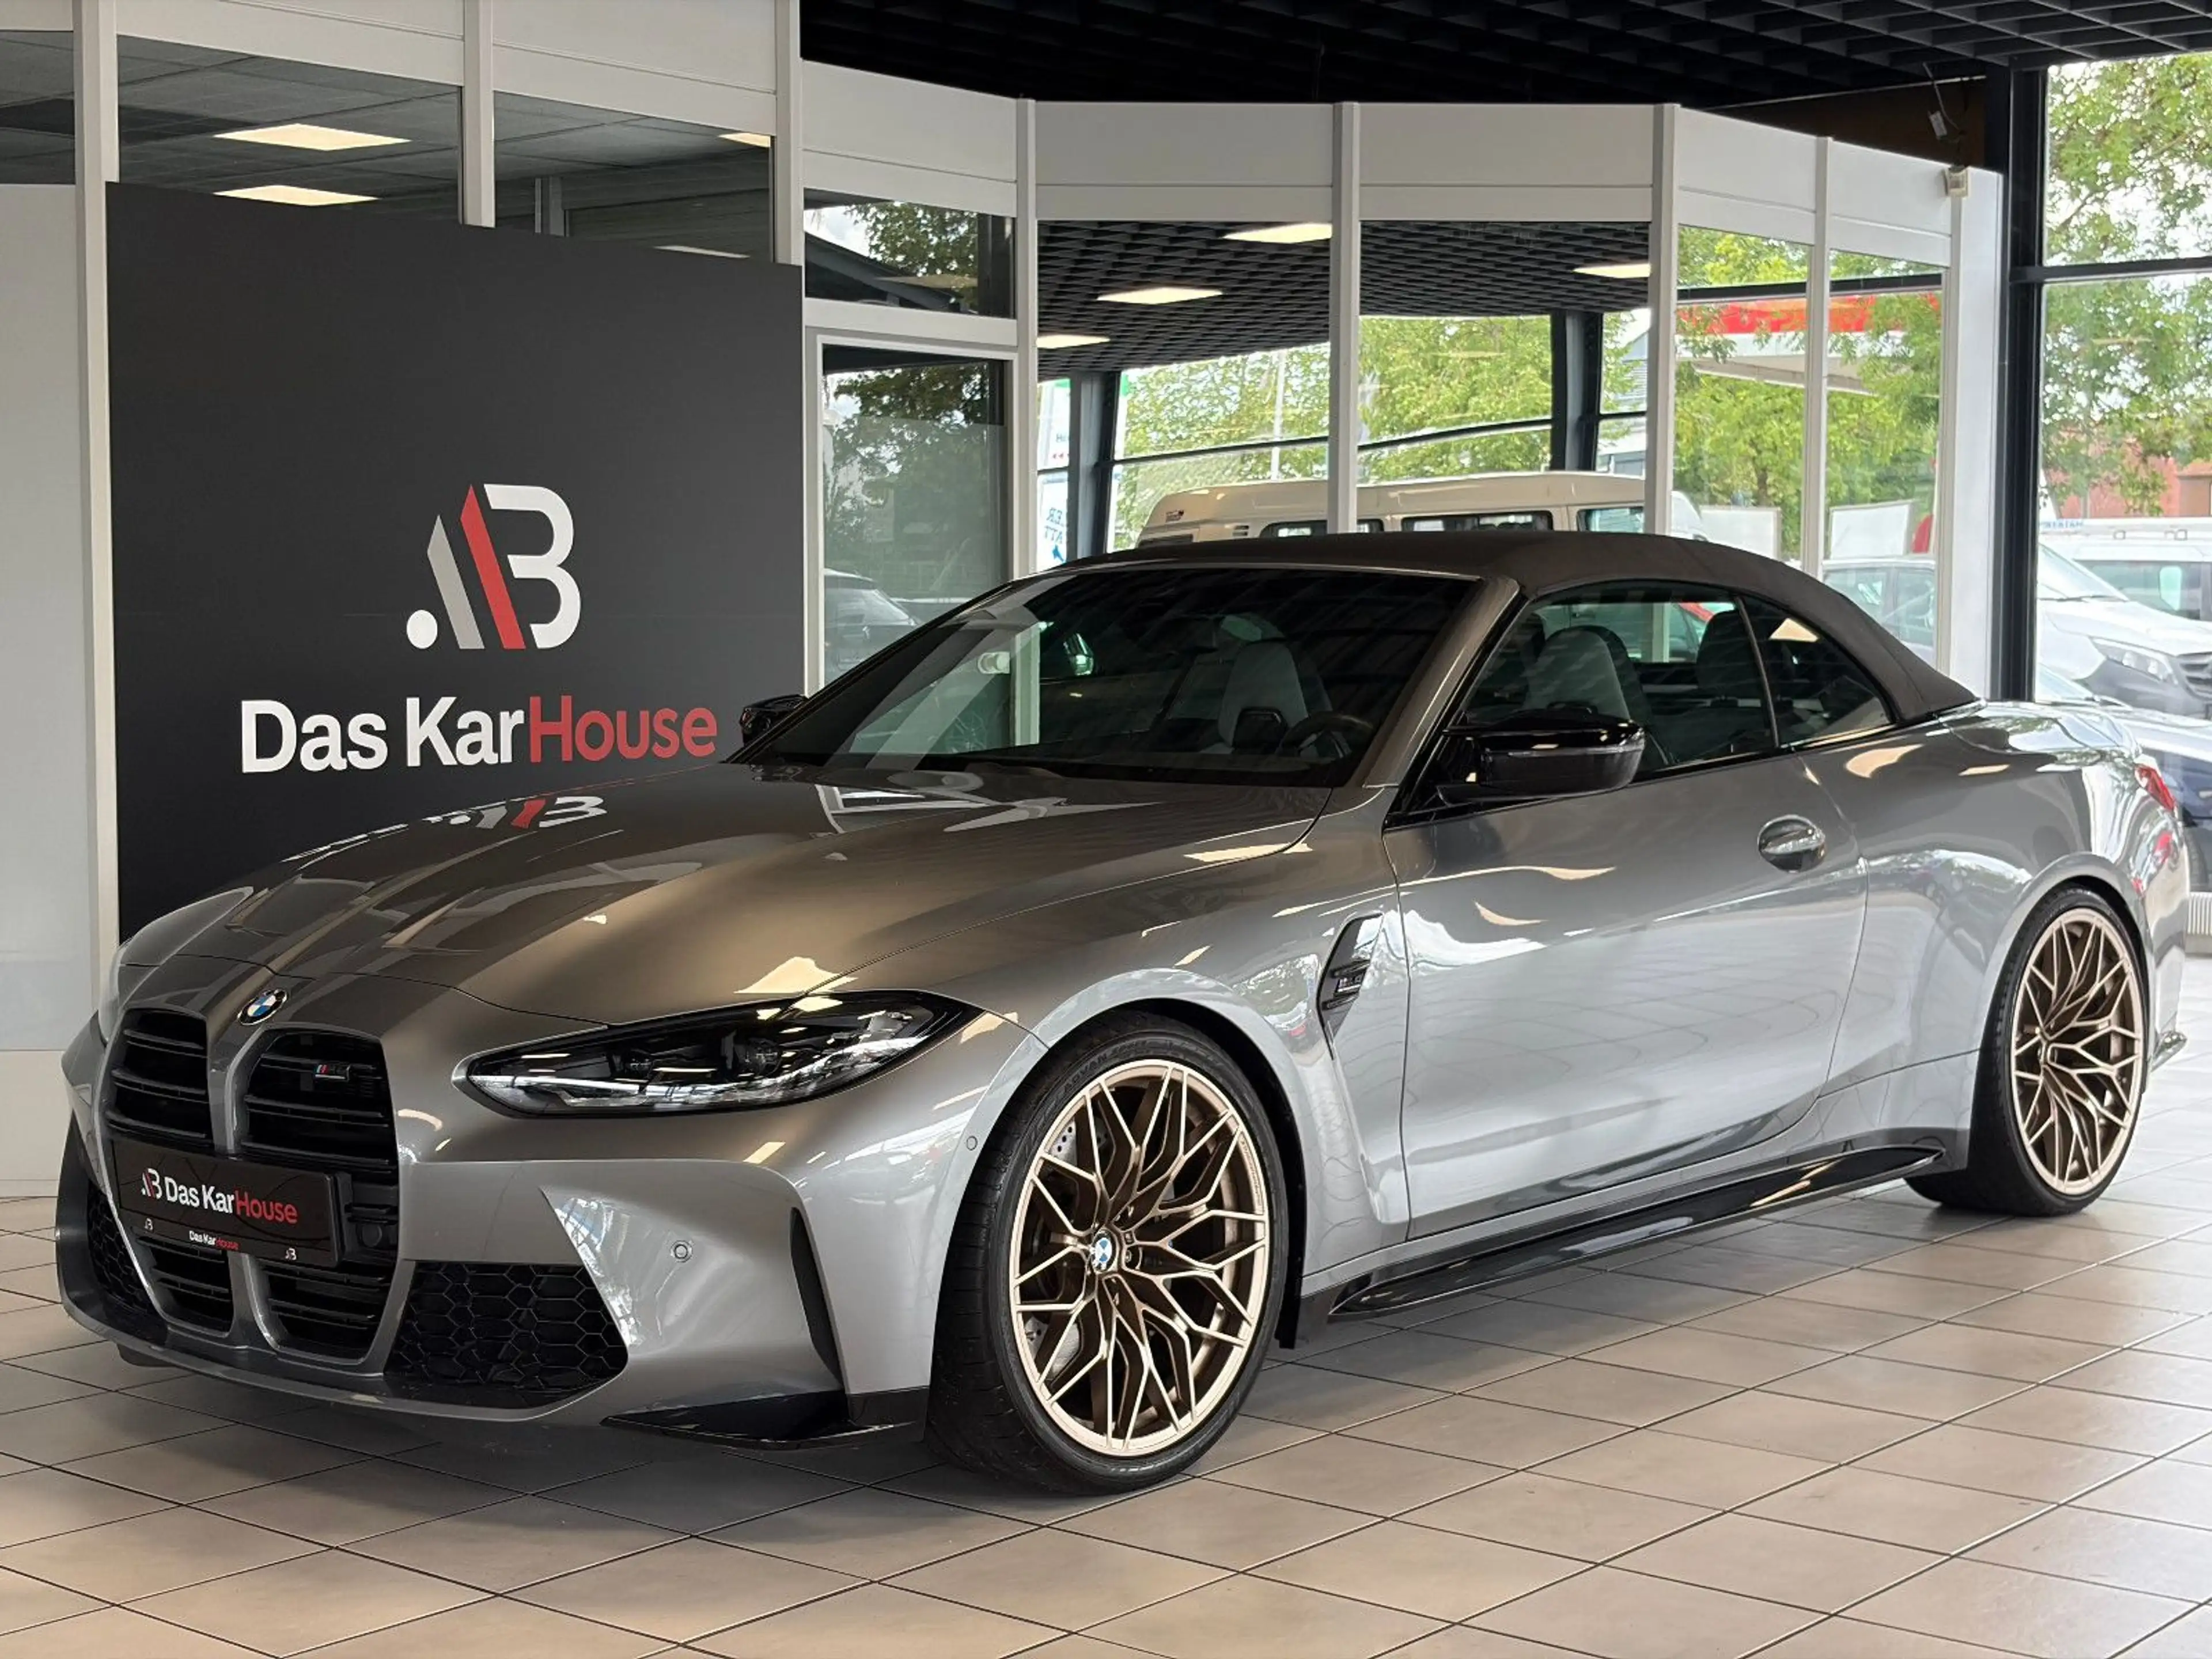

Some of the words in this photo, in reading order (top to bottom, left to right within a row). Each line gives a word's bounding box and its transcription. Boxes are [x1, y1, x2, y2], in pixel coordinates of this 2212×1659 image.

[242, 700, 388, 773] Das
[407, 696, 717, 766] KarHouse
[165, 1176, 199, 1207] Das
[202, 1184, 298, 1224] KarHouse
